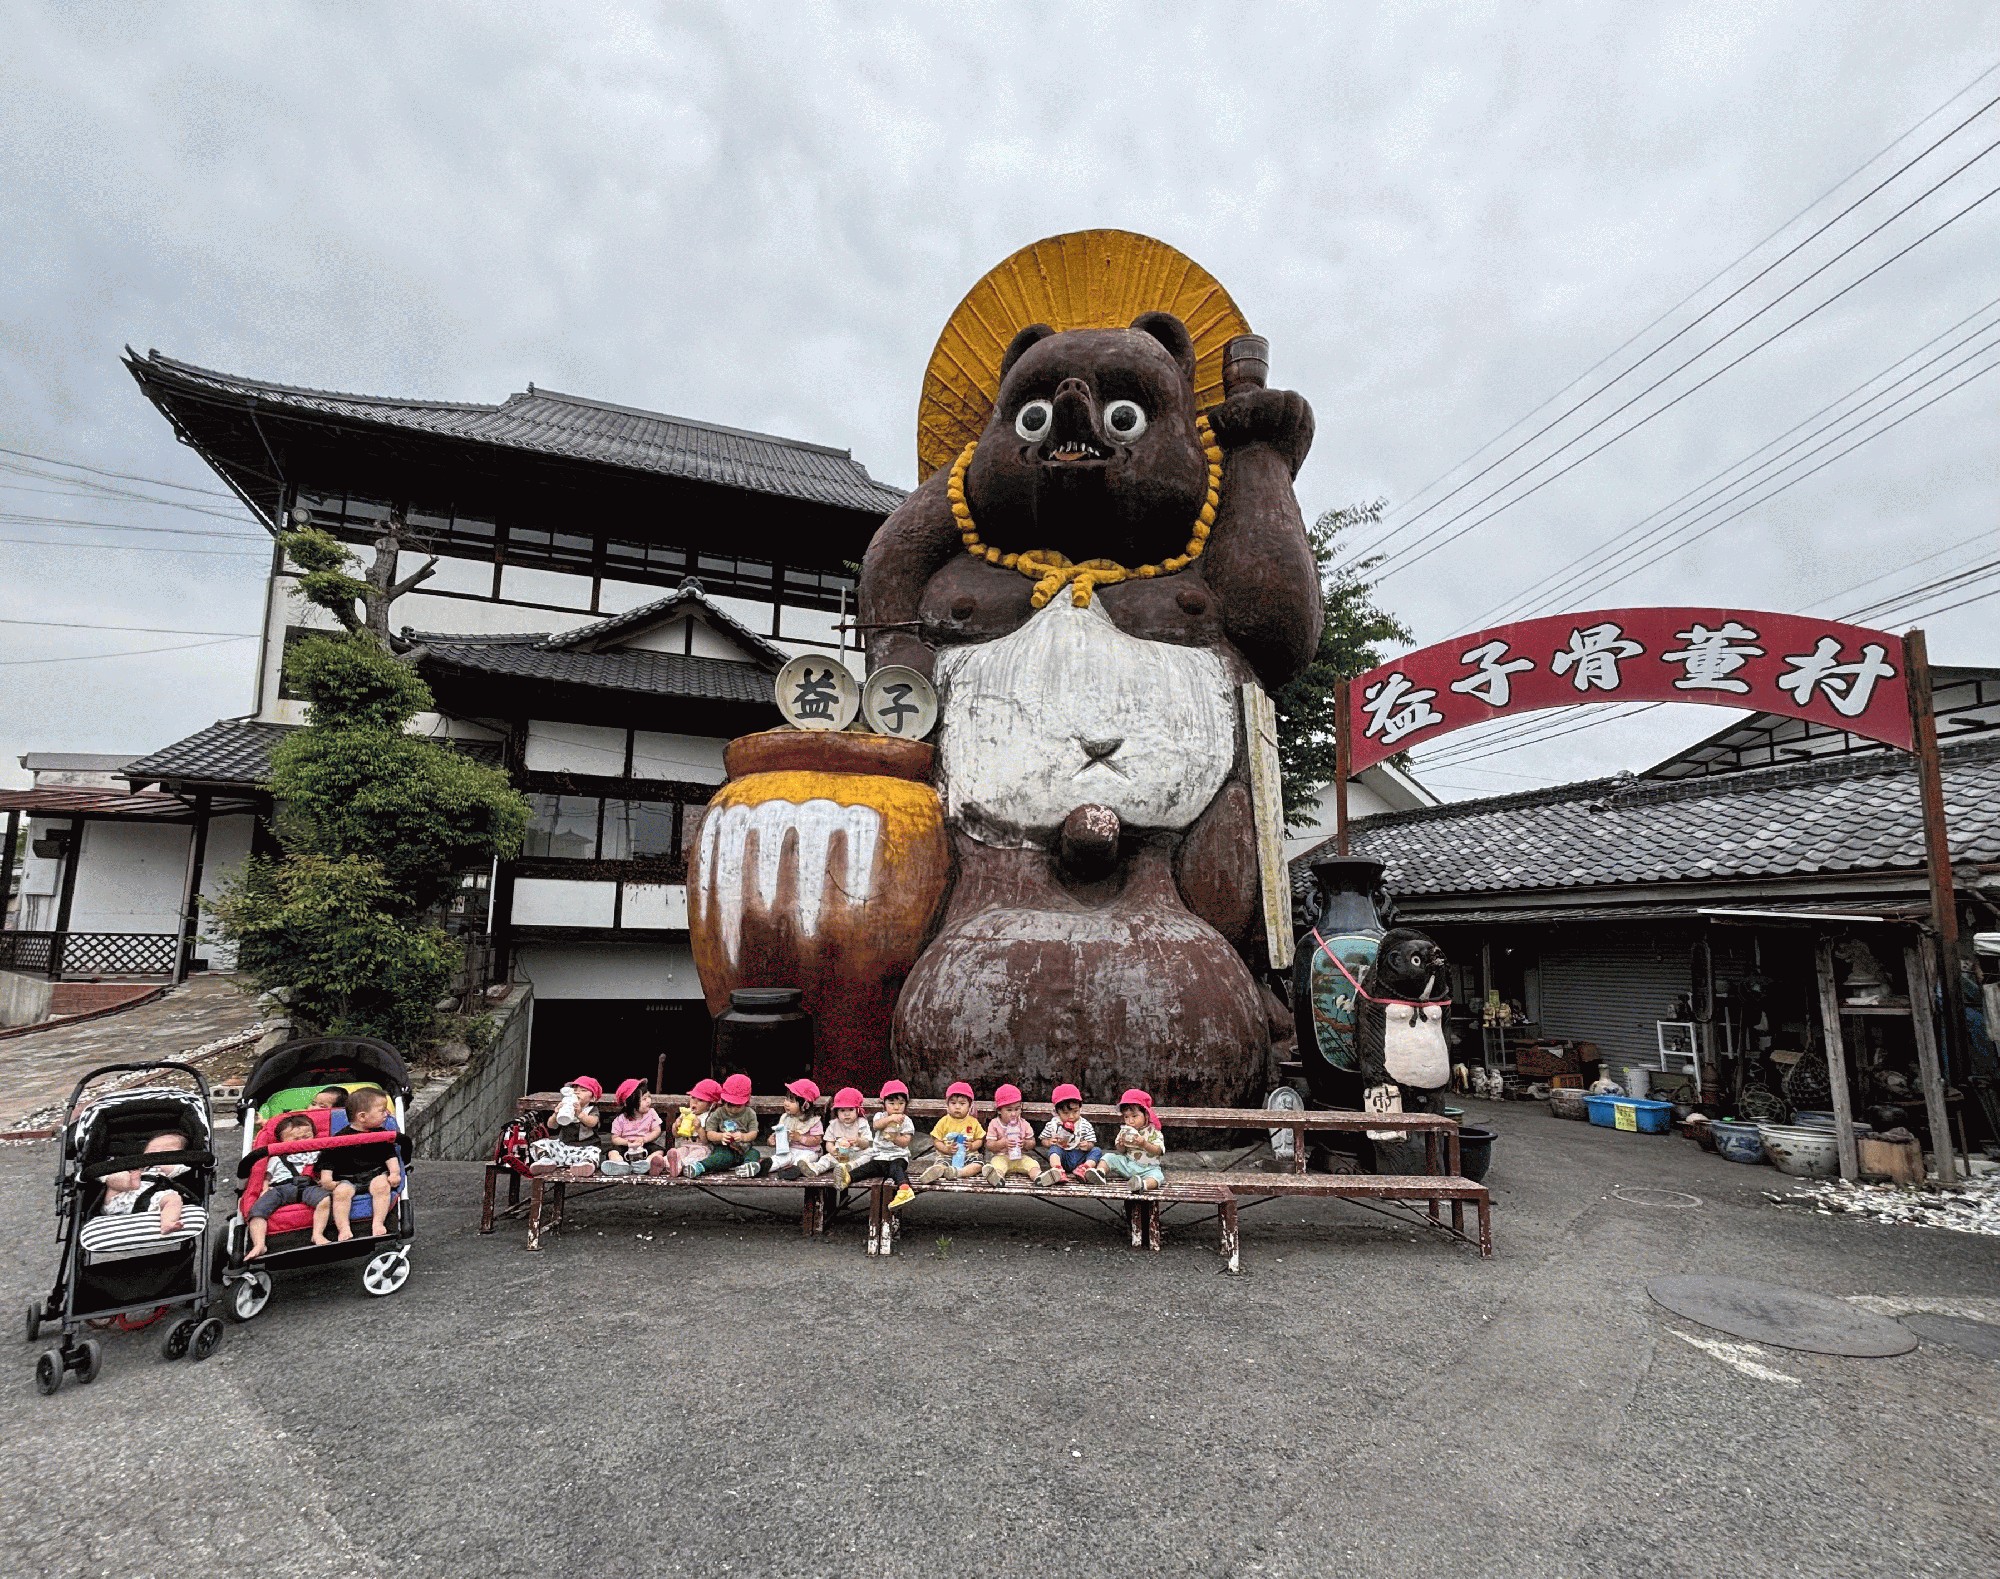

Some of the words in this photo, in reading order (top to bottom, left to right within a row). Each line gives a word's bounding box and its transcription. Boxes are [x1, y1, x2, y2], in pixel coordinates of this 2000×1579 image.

[1361, 621, 1896, 745] 益子骨董村
